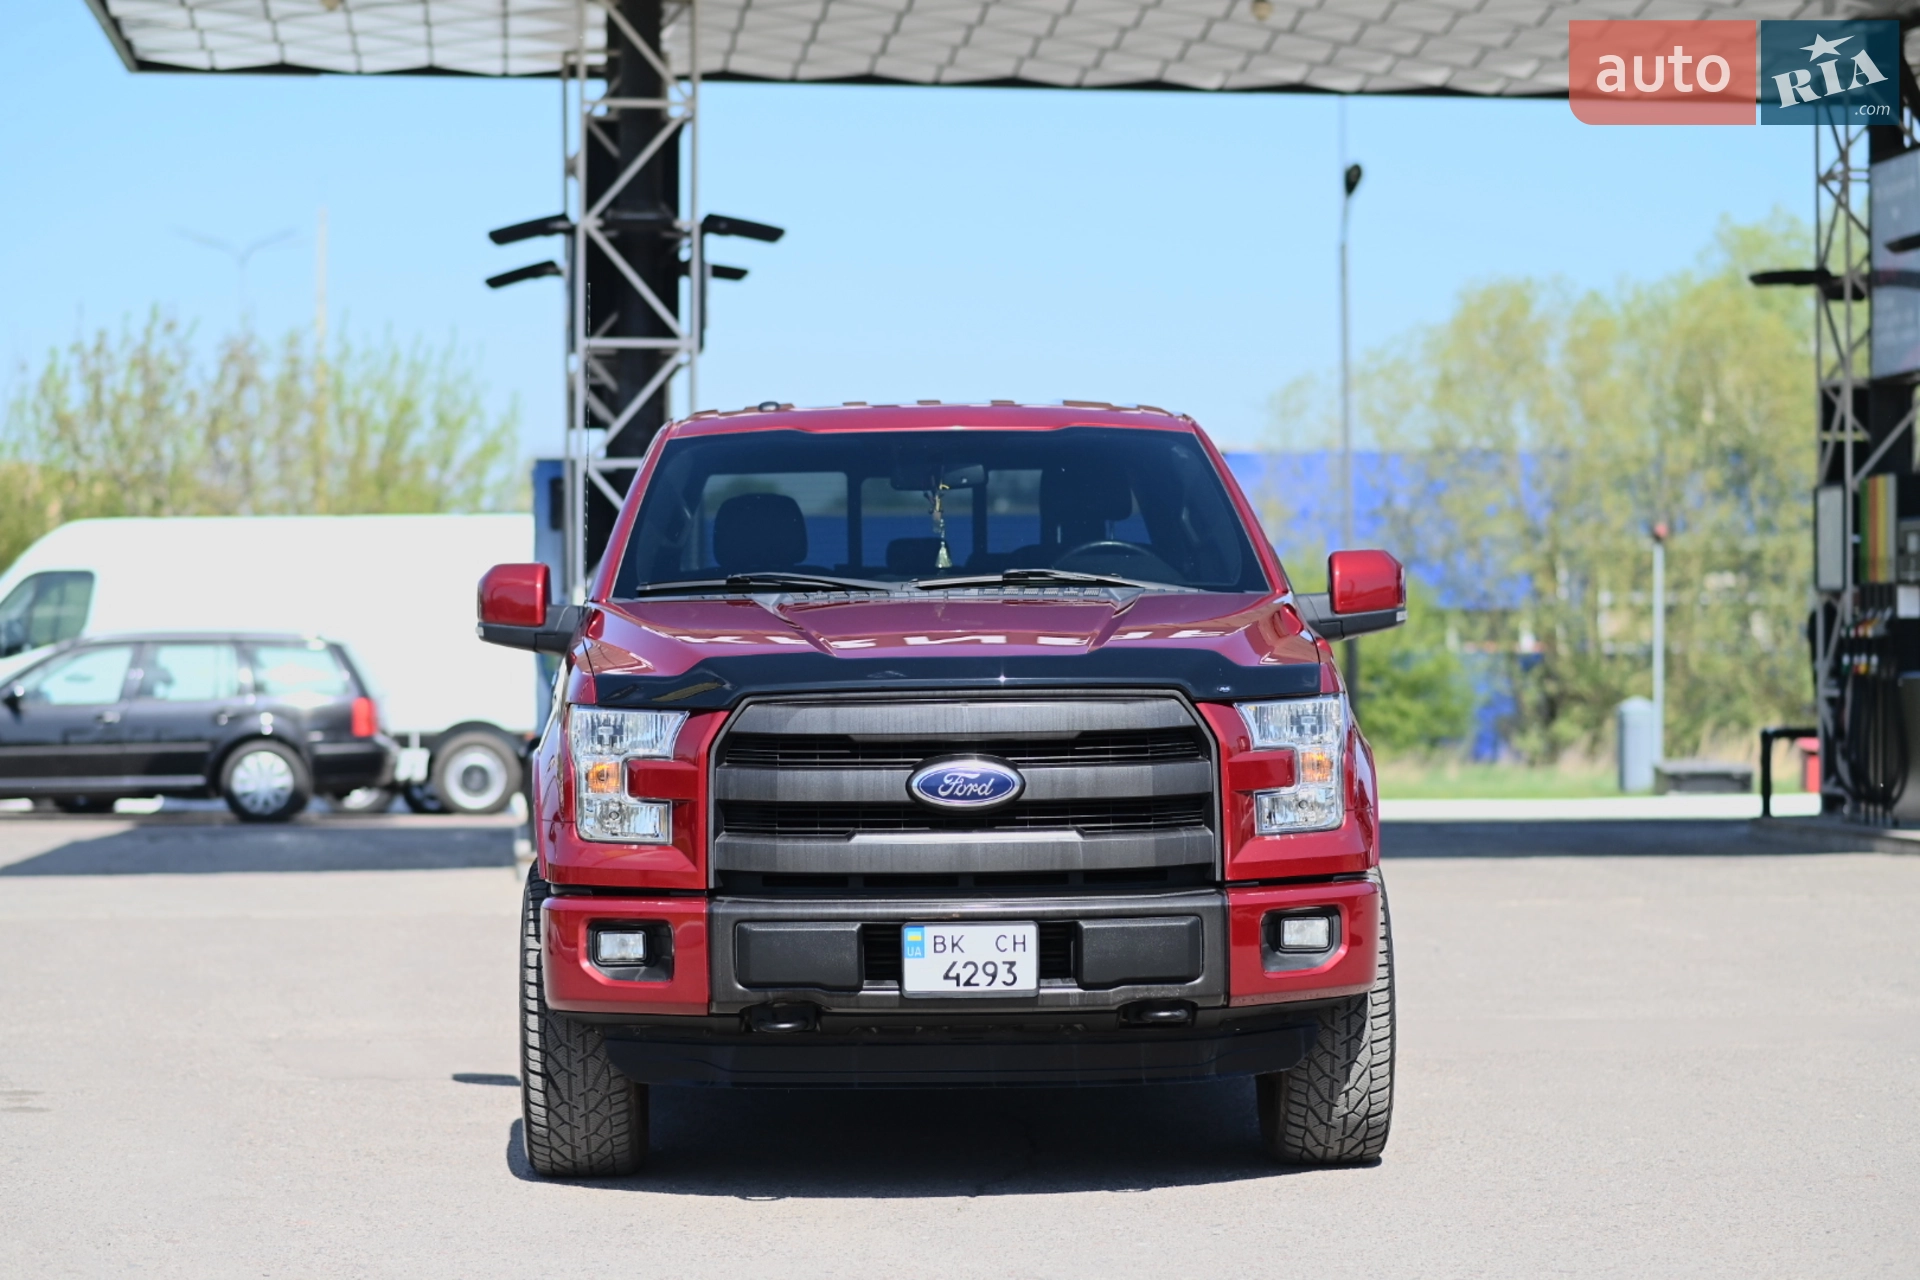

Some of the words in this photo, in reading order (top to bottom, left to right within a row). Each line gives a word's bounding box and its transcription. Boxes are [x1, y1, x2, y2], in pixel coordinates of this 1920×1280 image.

[937, 773, 994, 797] Ford
[907, 946, 922, 957] UA
[933, 934, 965, 954] BK
[995, 934, 1027, 953] CH
[943, 960, 1018, 987] 4293
